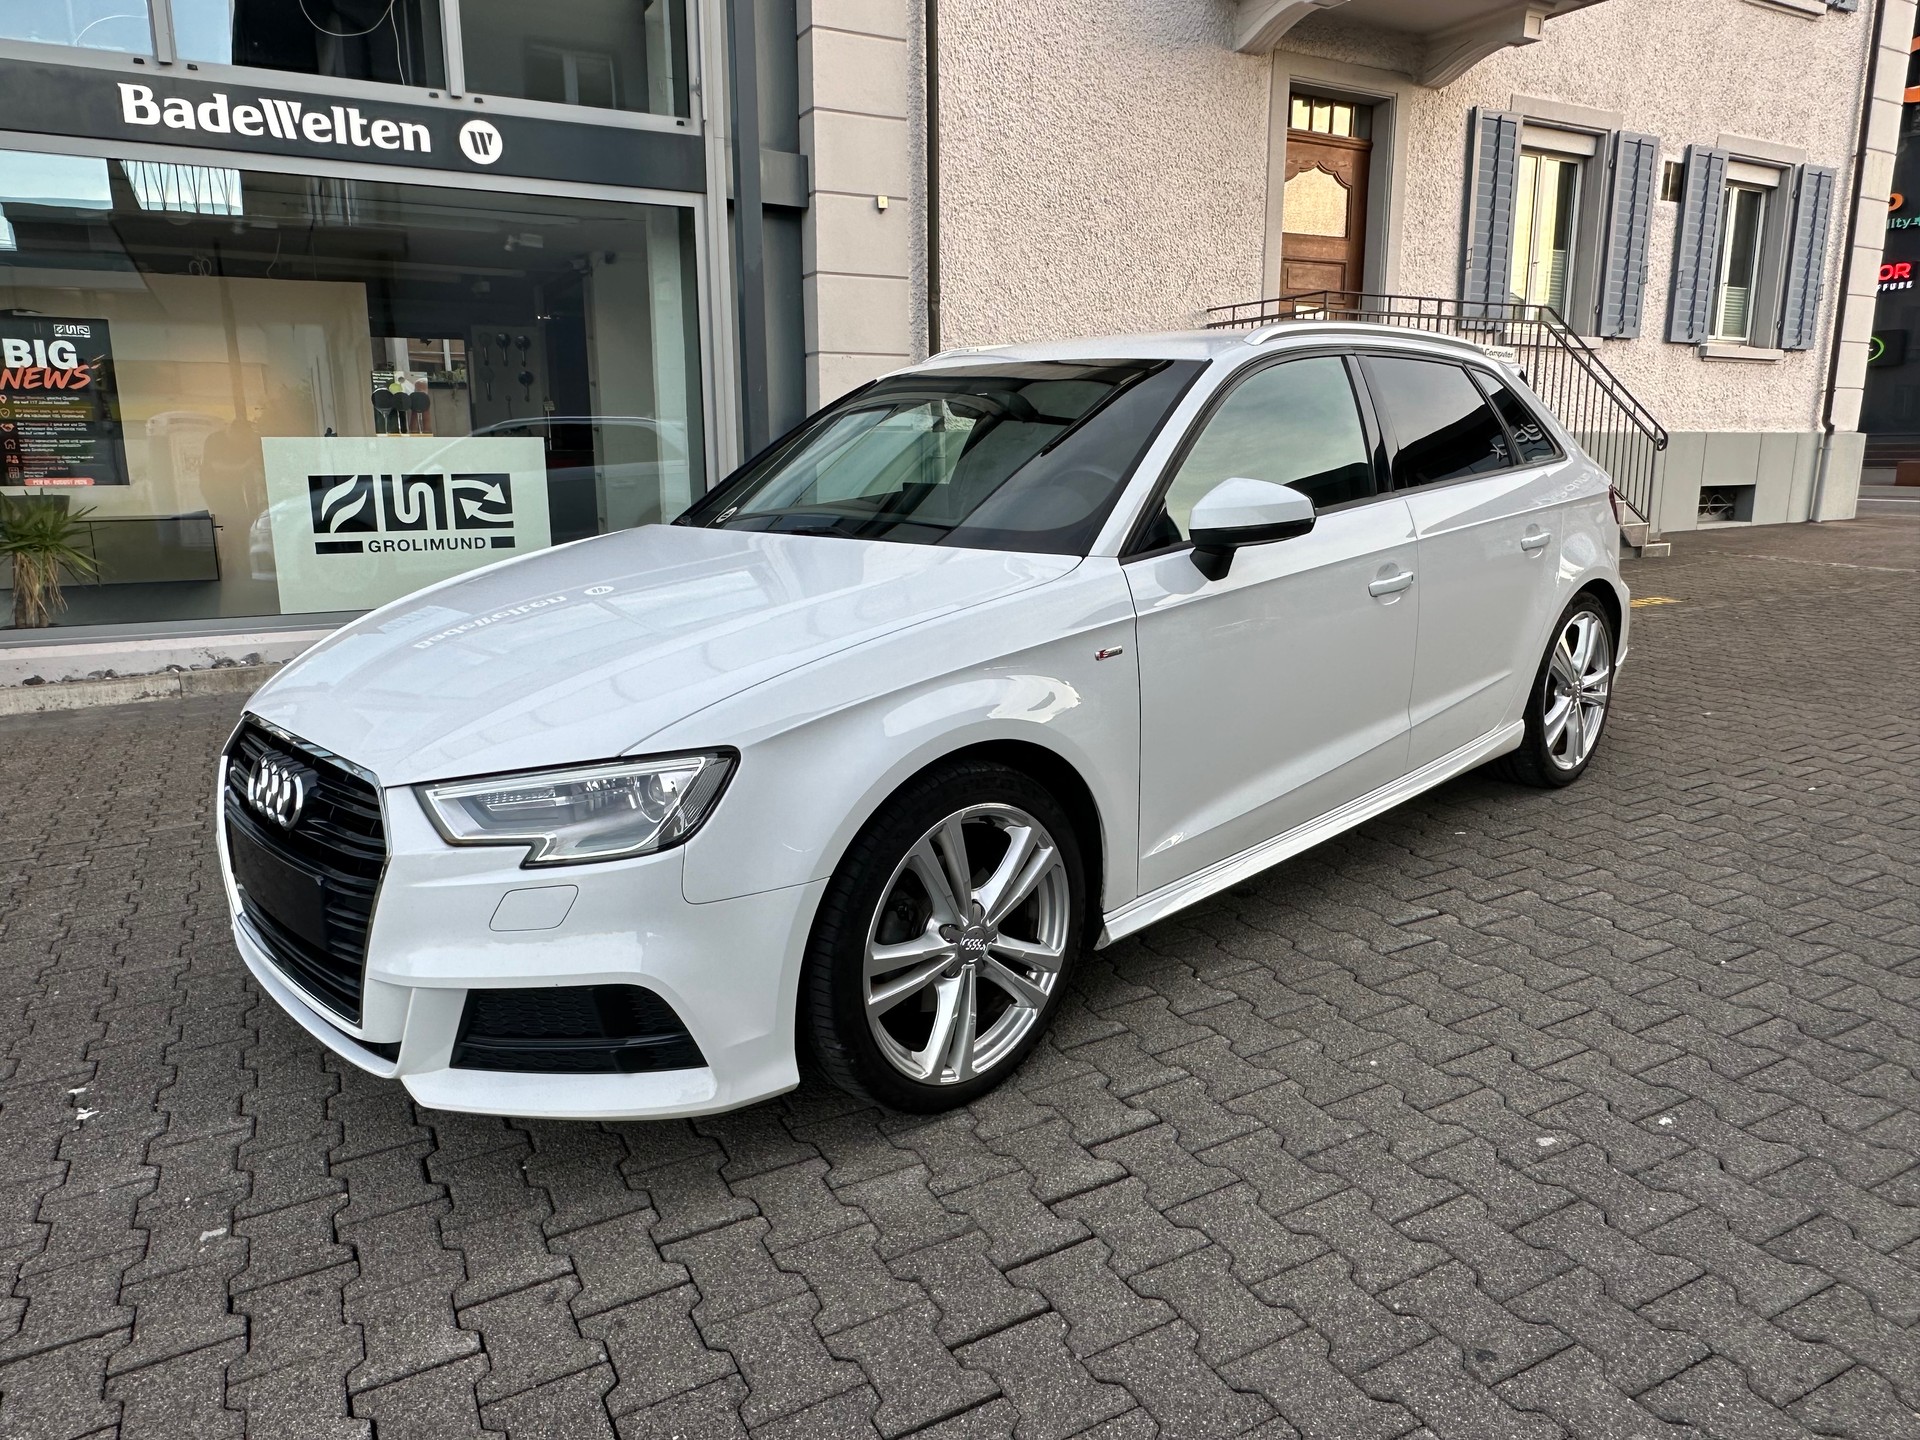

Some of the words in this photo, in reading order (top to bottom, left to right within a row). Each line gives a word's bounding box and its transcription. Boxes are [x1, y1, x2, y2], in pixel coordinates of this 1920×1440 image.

[117, 83, 431, 152] BadeWelten
[2, 338, 78, 369] BIG
[0, 365, 91, 390] NEWS
[368, 537, 486, 553] GROLIMUND
